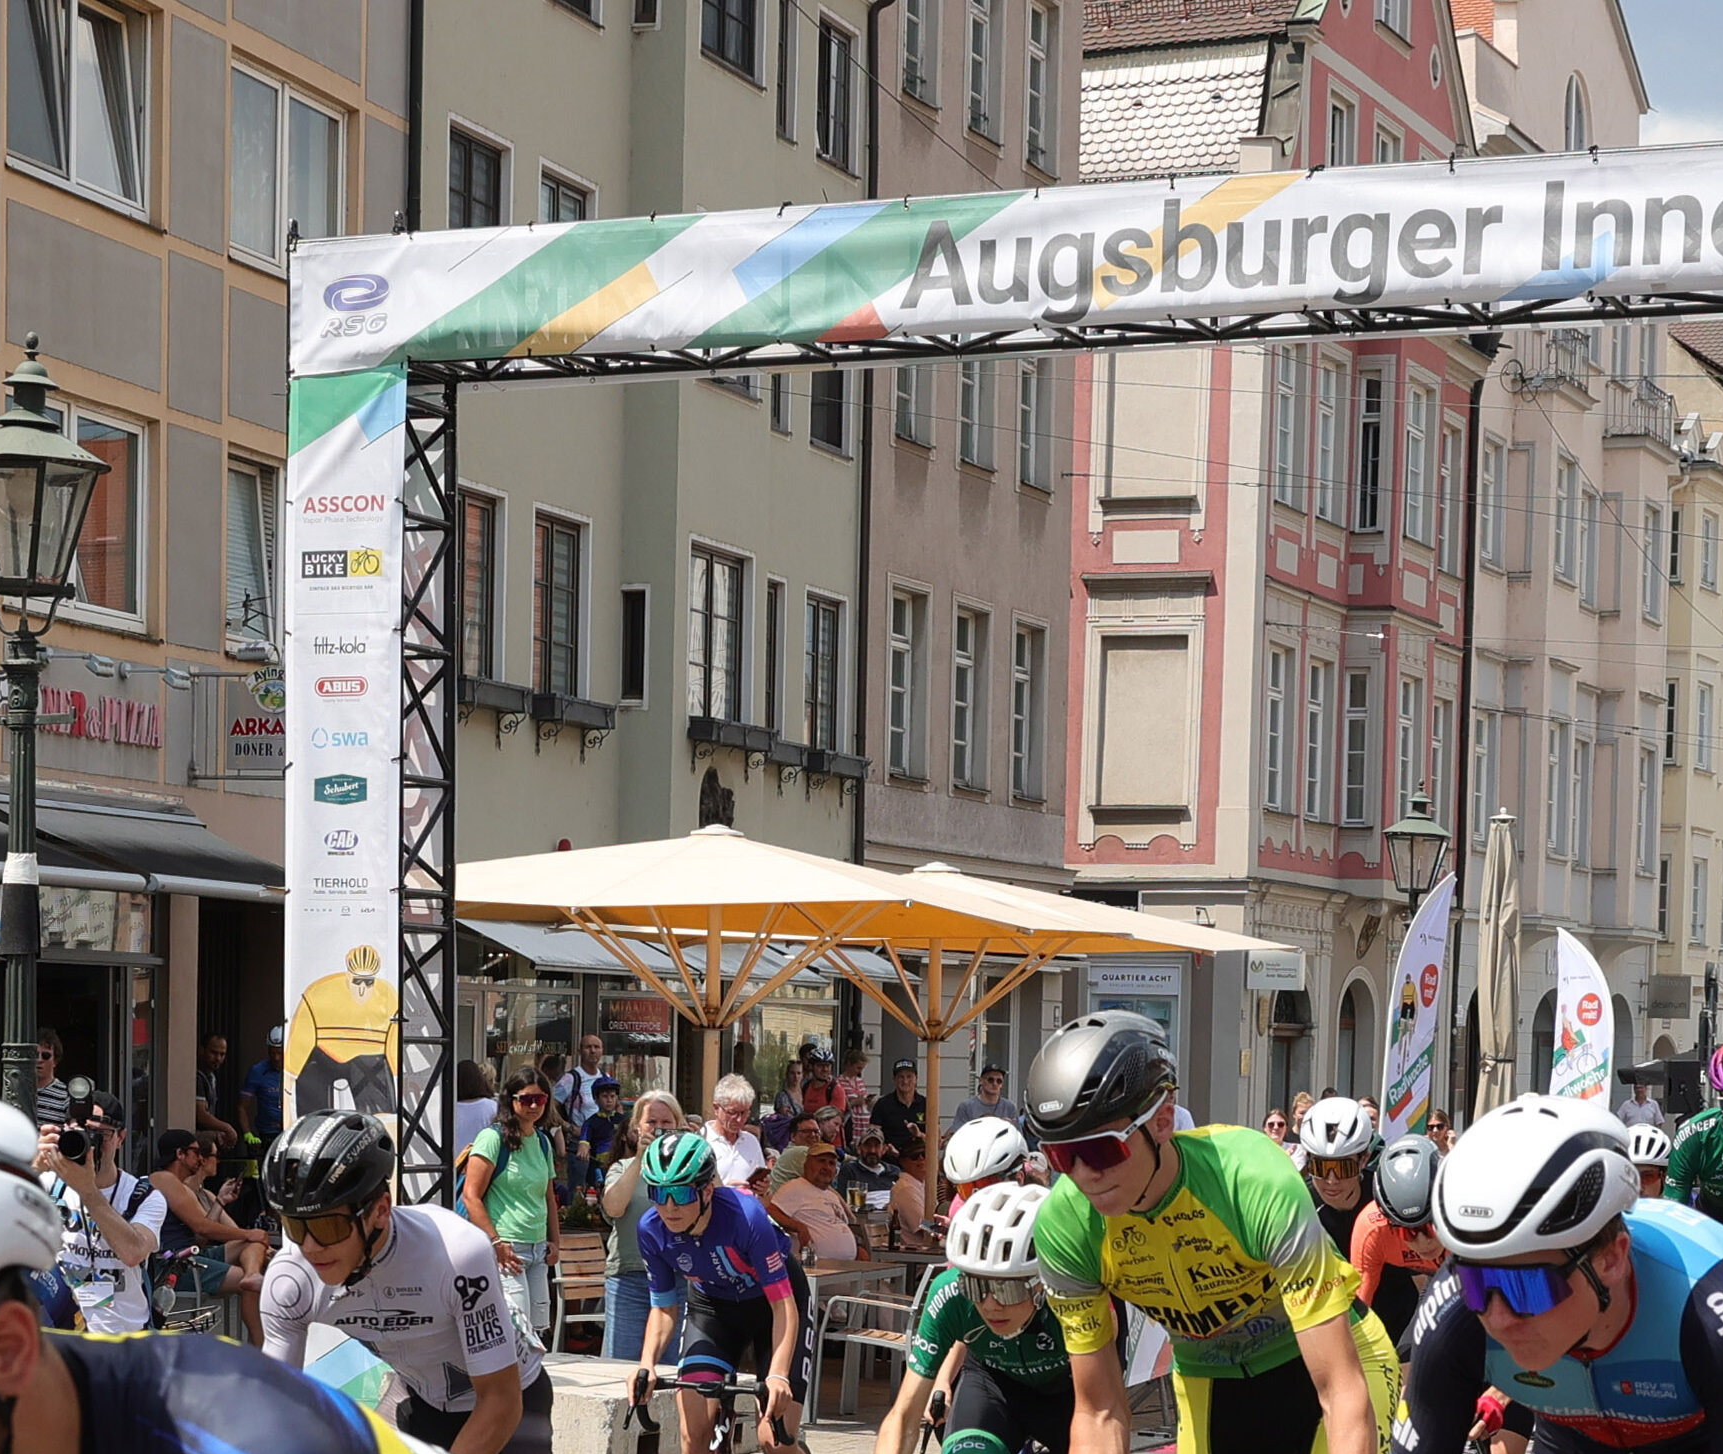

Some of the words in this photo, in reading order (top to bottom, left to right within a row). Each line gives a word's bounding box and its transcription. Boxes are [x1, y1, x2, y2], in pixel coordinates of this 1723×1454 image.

[900, 197, 1503, 323] Augsburger
[319, 312, 389, 338] RSG
[302, 494, 385, 514] ASSCON
[304, 553, 346, 564] LUCKY
[304, 564, 345, 576] BIKE
[313, 636, 367, 655] fritz-kola
[253, 666, 285, 682] Aying
[322, 680, 362, 693] ABUS
[40, 685, 87, 737] NER
[87, 706, 103, 739] &
[101, 696, 162, 749] PIZZA
[230, 717, 286, 737] ARKA
[331, 731, 369, 747] swa
[234, 740, 274, 757] DÖNER
[323, 781, 360, 796] Schubert
[326, 830, 356, 849] CAB
[313, 878, 369, 889] TIERHOLD
[1101, 972, 1147, 982] QUARTIER
[1148, 973, 1173, 983] ACHT
[1581, 1000, 1599, 1011] Radl
[608, 1020, 662, 1032] ORIENTTEPPICHE
[1387, 1053, 1430, 1106] Radlwoche
[1673, 1116, 1718, 1151] BIORACER
[1462, 1208, 1490, 1217] ABUS
[927, 1277, 961, 1320] BIORAC
[463, 1302, 499, 1327] OLIVER
[1412, 1273, 1462, 1346] alpin
[334, 1314, 379, 1327] AUTO
[382, 1314, 434, 1328] EDER
[464, 1317, 505, 1347] BLAS
[467, 1336, 507, 1355] YOUNGSTERS
[1634, 1381, 1658, 1390] RSV
[1635, 1389, 1678, 1399] PASSAU
